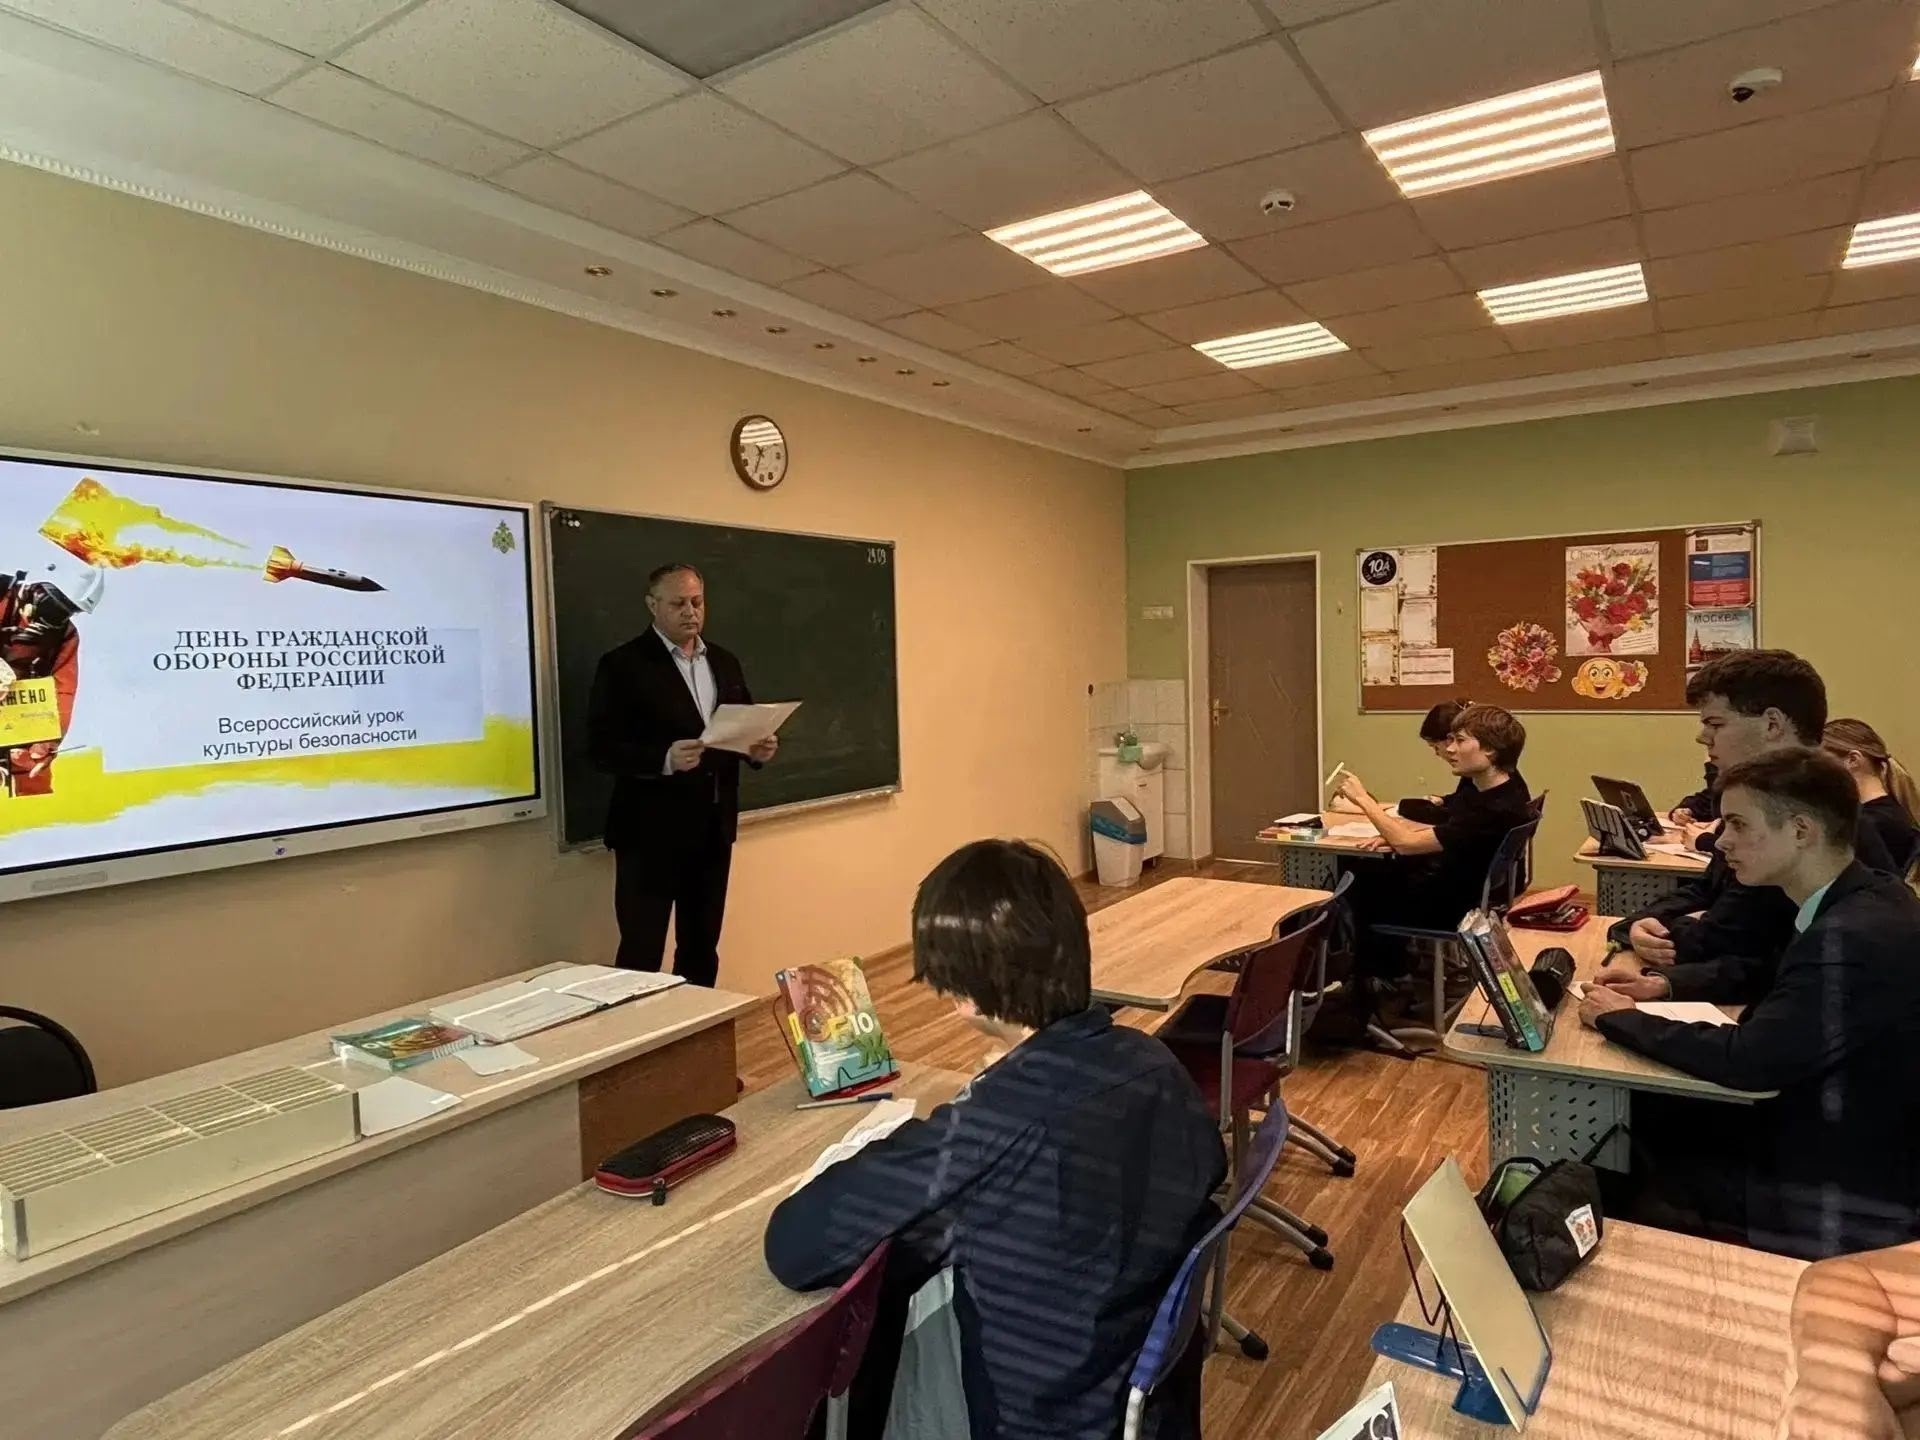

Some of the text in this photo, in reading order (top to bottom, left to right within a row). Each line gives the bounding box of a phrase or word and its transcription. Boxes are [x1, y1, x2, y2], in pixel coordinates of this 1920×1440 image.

[1693, 613, 1740, 624] МОСКВА
[174, 626, 429, 651] ДЕНЬ ГРАЖДАНСКОЙ
[153, 645, 446, 671] ОБОРОНЫ РОССИЙСКОЙ
[236, 669, 385, 692] ФЕДЕРАЦИИ
[218, 710, 405, 735] Всероссийский урок
[203, 727, 418, 760] культуры безопасности
[848, 1012, 874, 1036] 10
